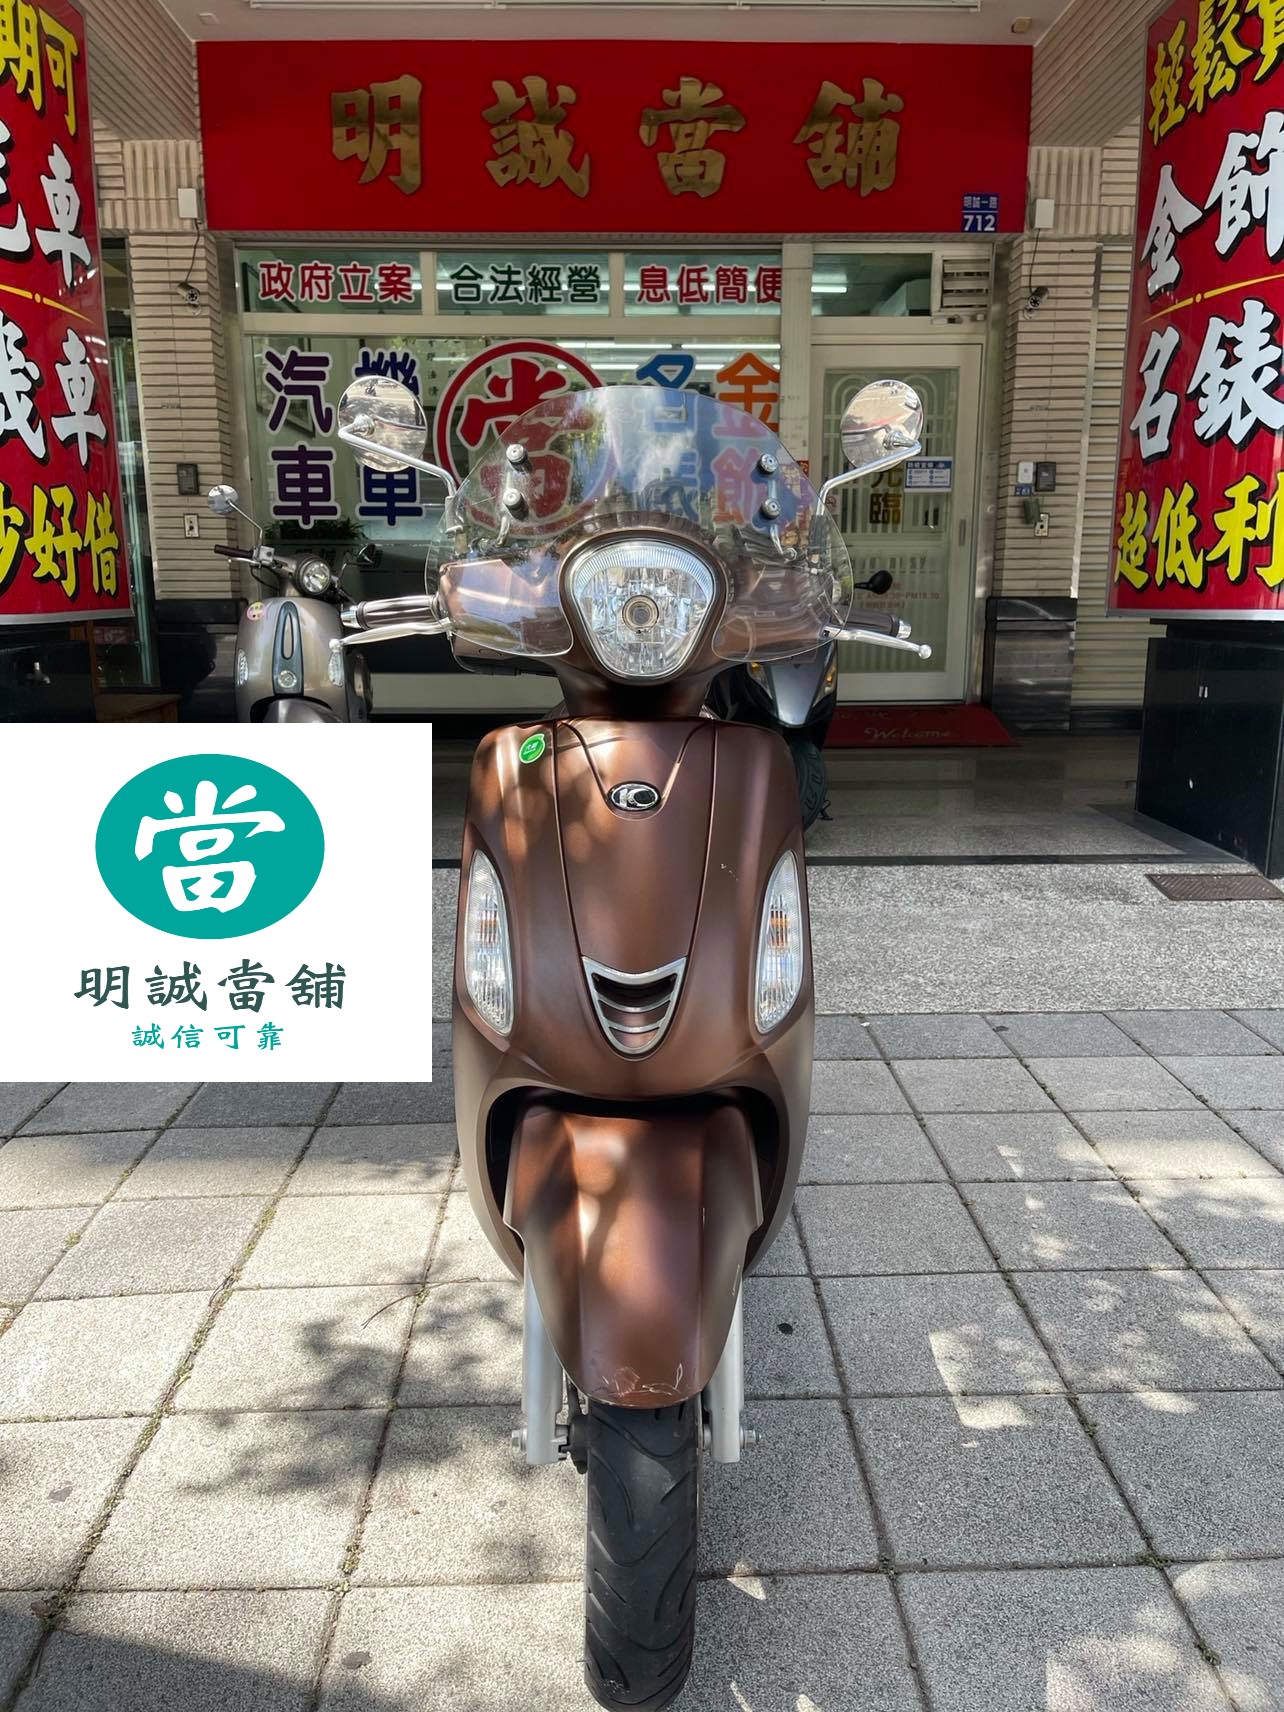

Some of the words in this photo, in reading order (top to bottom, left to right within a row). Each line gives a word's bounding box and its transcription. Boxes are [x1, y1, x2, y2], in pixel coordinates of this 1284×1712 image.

[963, 214, 996, 232] 712
[259, 261, 415, 302] 政府立案
[450, 262, 602, 303] 合法經營
[637, 264, 783, 305] 息低簡便
[1130, 300, 1284, 459] 名錶
[265, 350, 338, 526] 汽車
[1115, 472, 1284, 589] 超低利
